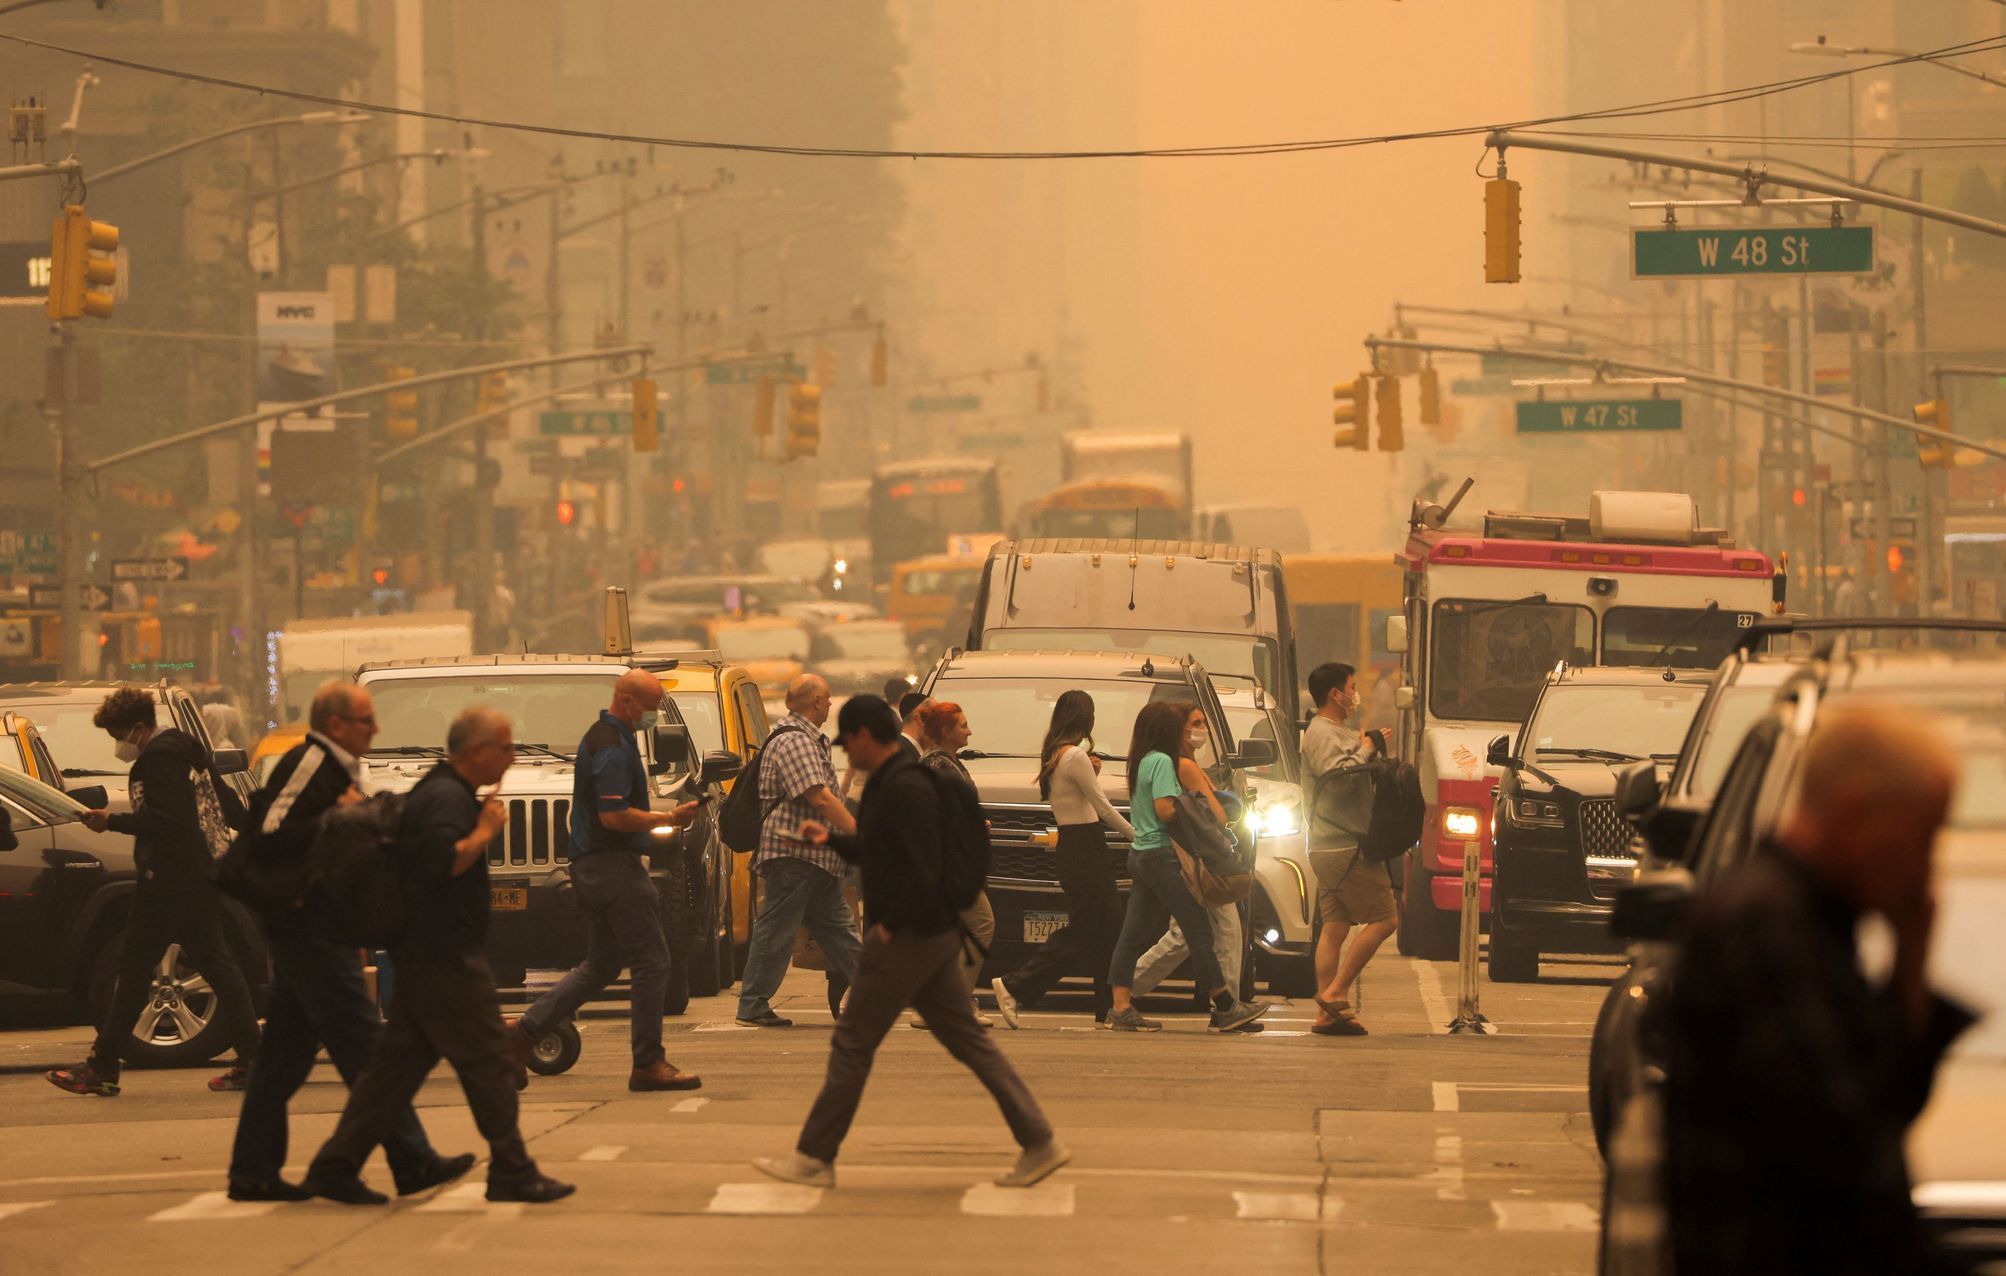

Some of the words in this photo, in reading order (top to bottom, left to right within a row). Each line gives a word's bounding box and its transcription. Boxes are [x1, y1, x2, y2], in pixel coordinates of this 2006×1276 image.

[1697, 237, 1719, 267] W
[1731, 236, 1767, 266] 48
[1781, 235, 1809, 265] St
[277, 306, 315, 318] NYC
[1560, 405, 1577, 427] W
[1583, 405, 1609, 427] 47
[1617, 405, 1639, 427] St
[1739, 615, 1752, 627] 27
